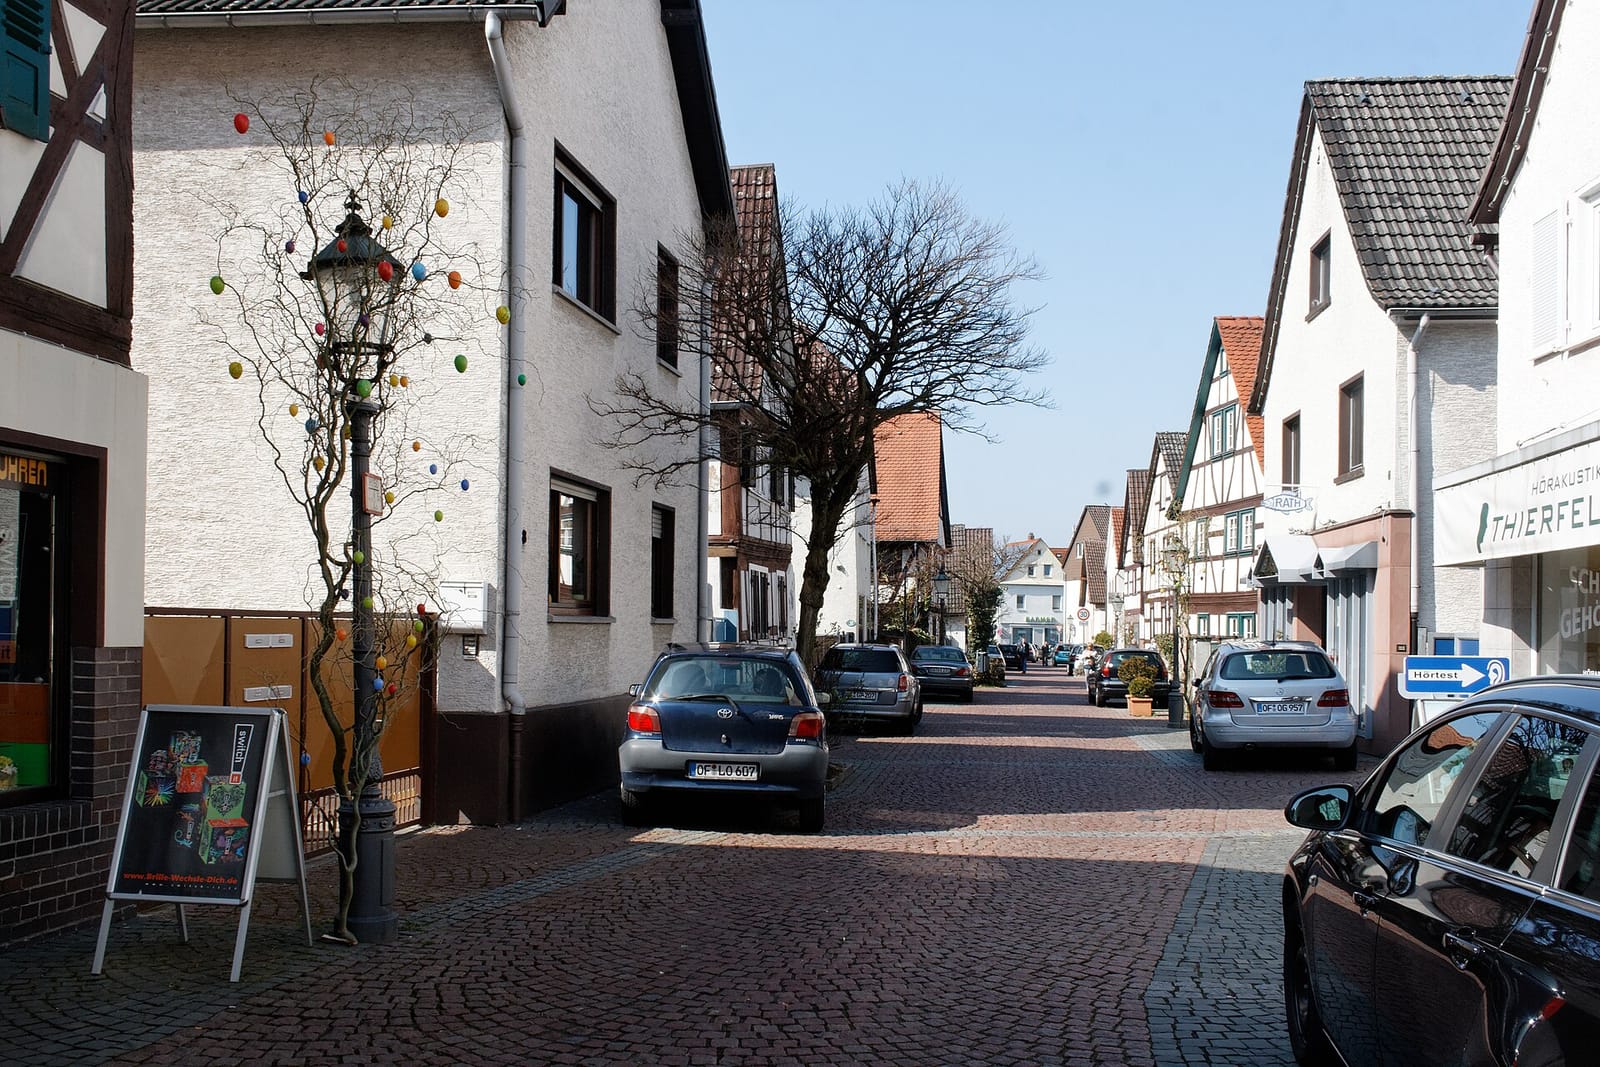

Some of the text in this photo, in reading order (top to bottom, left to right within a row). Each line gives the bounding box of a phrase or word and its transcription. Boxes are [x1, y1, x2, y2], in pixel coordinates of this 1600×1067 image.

[1532, 465, 1600, 495] HÖRAKUSTIK
[1275, 498, 1300, 508] RATH
[1493, 495, 1600, 542] THIERFEL
[1569, 566, 1600, 594] SCH
[1414, 671, 1458, 679] Hörtest
[1263, 704, 1272, 712] OF
[1289, 704, 1303, 712] 957
[235, 730, 247, 763] switch
[697, 764, 755, 777] OF LO 607
